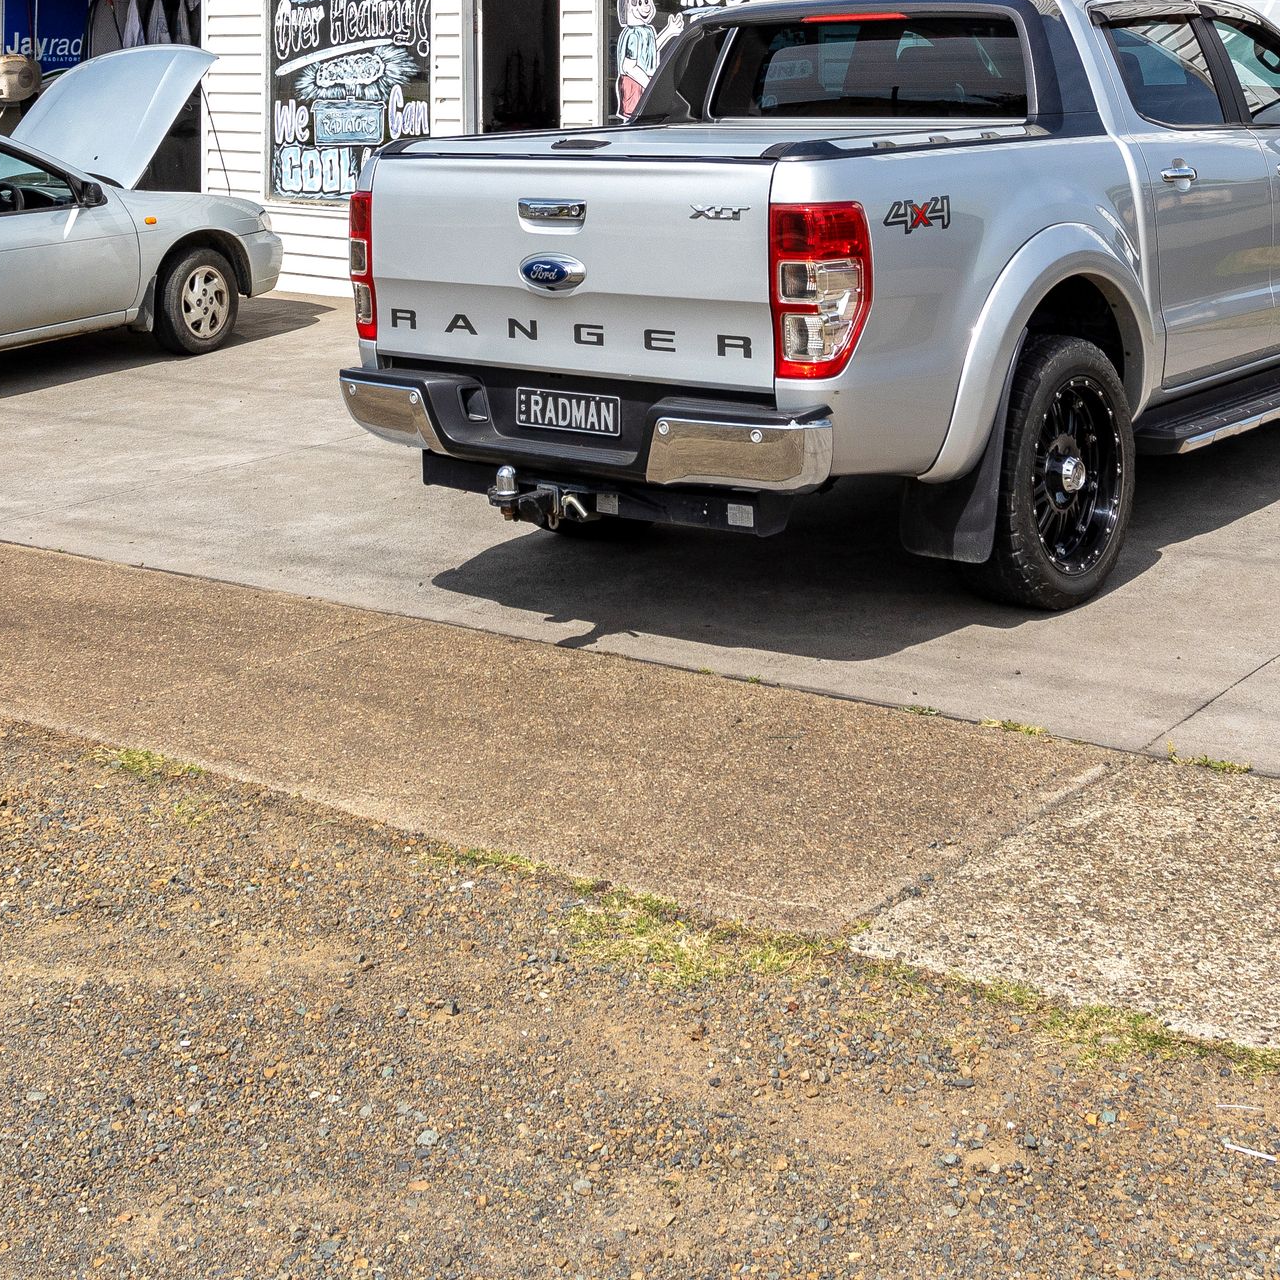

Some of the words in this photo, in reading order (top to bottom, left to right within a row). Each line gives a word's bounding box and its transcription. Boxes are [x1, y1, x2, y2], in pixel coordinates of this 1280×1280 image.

[6, 32, 84, 60] Jayrad
[275, 99, 309, 144] We
[388, 84, 430, 140] Can
[322, 119, 377, 136] RADIATORS
[280, 146, 356, 193] COOL
[689, 204, 751, 221] XLT
[531, 263, 558, 280] Ford
[391, 308, 752, 359] RANGER
[530, 395, 614, 431] RADMAN
